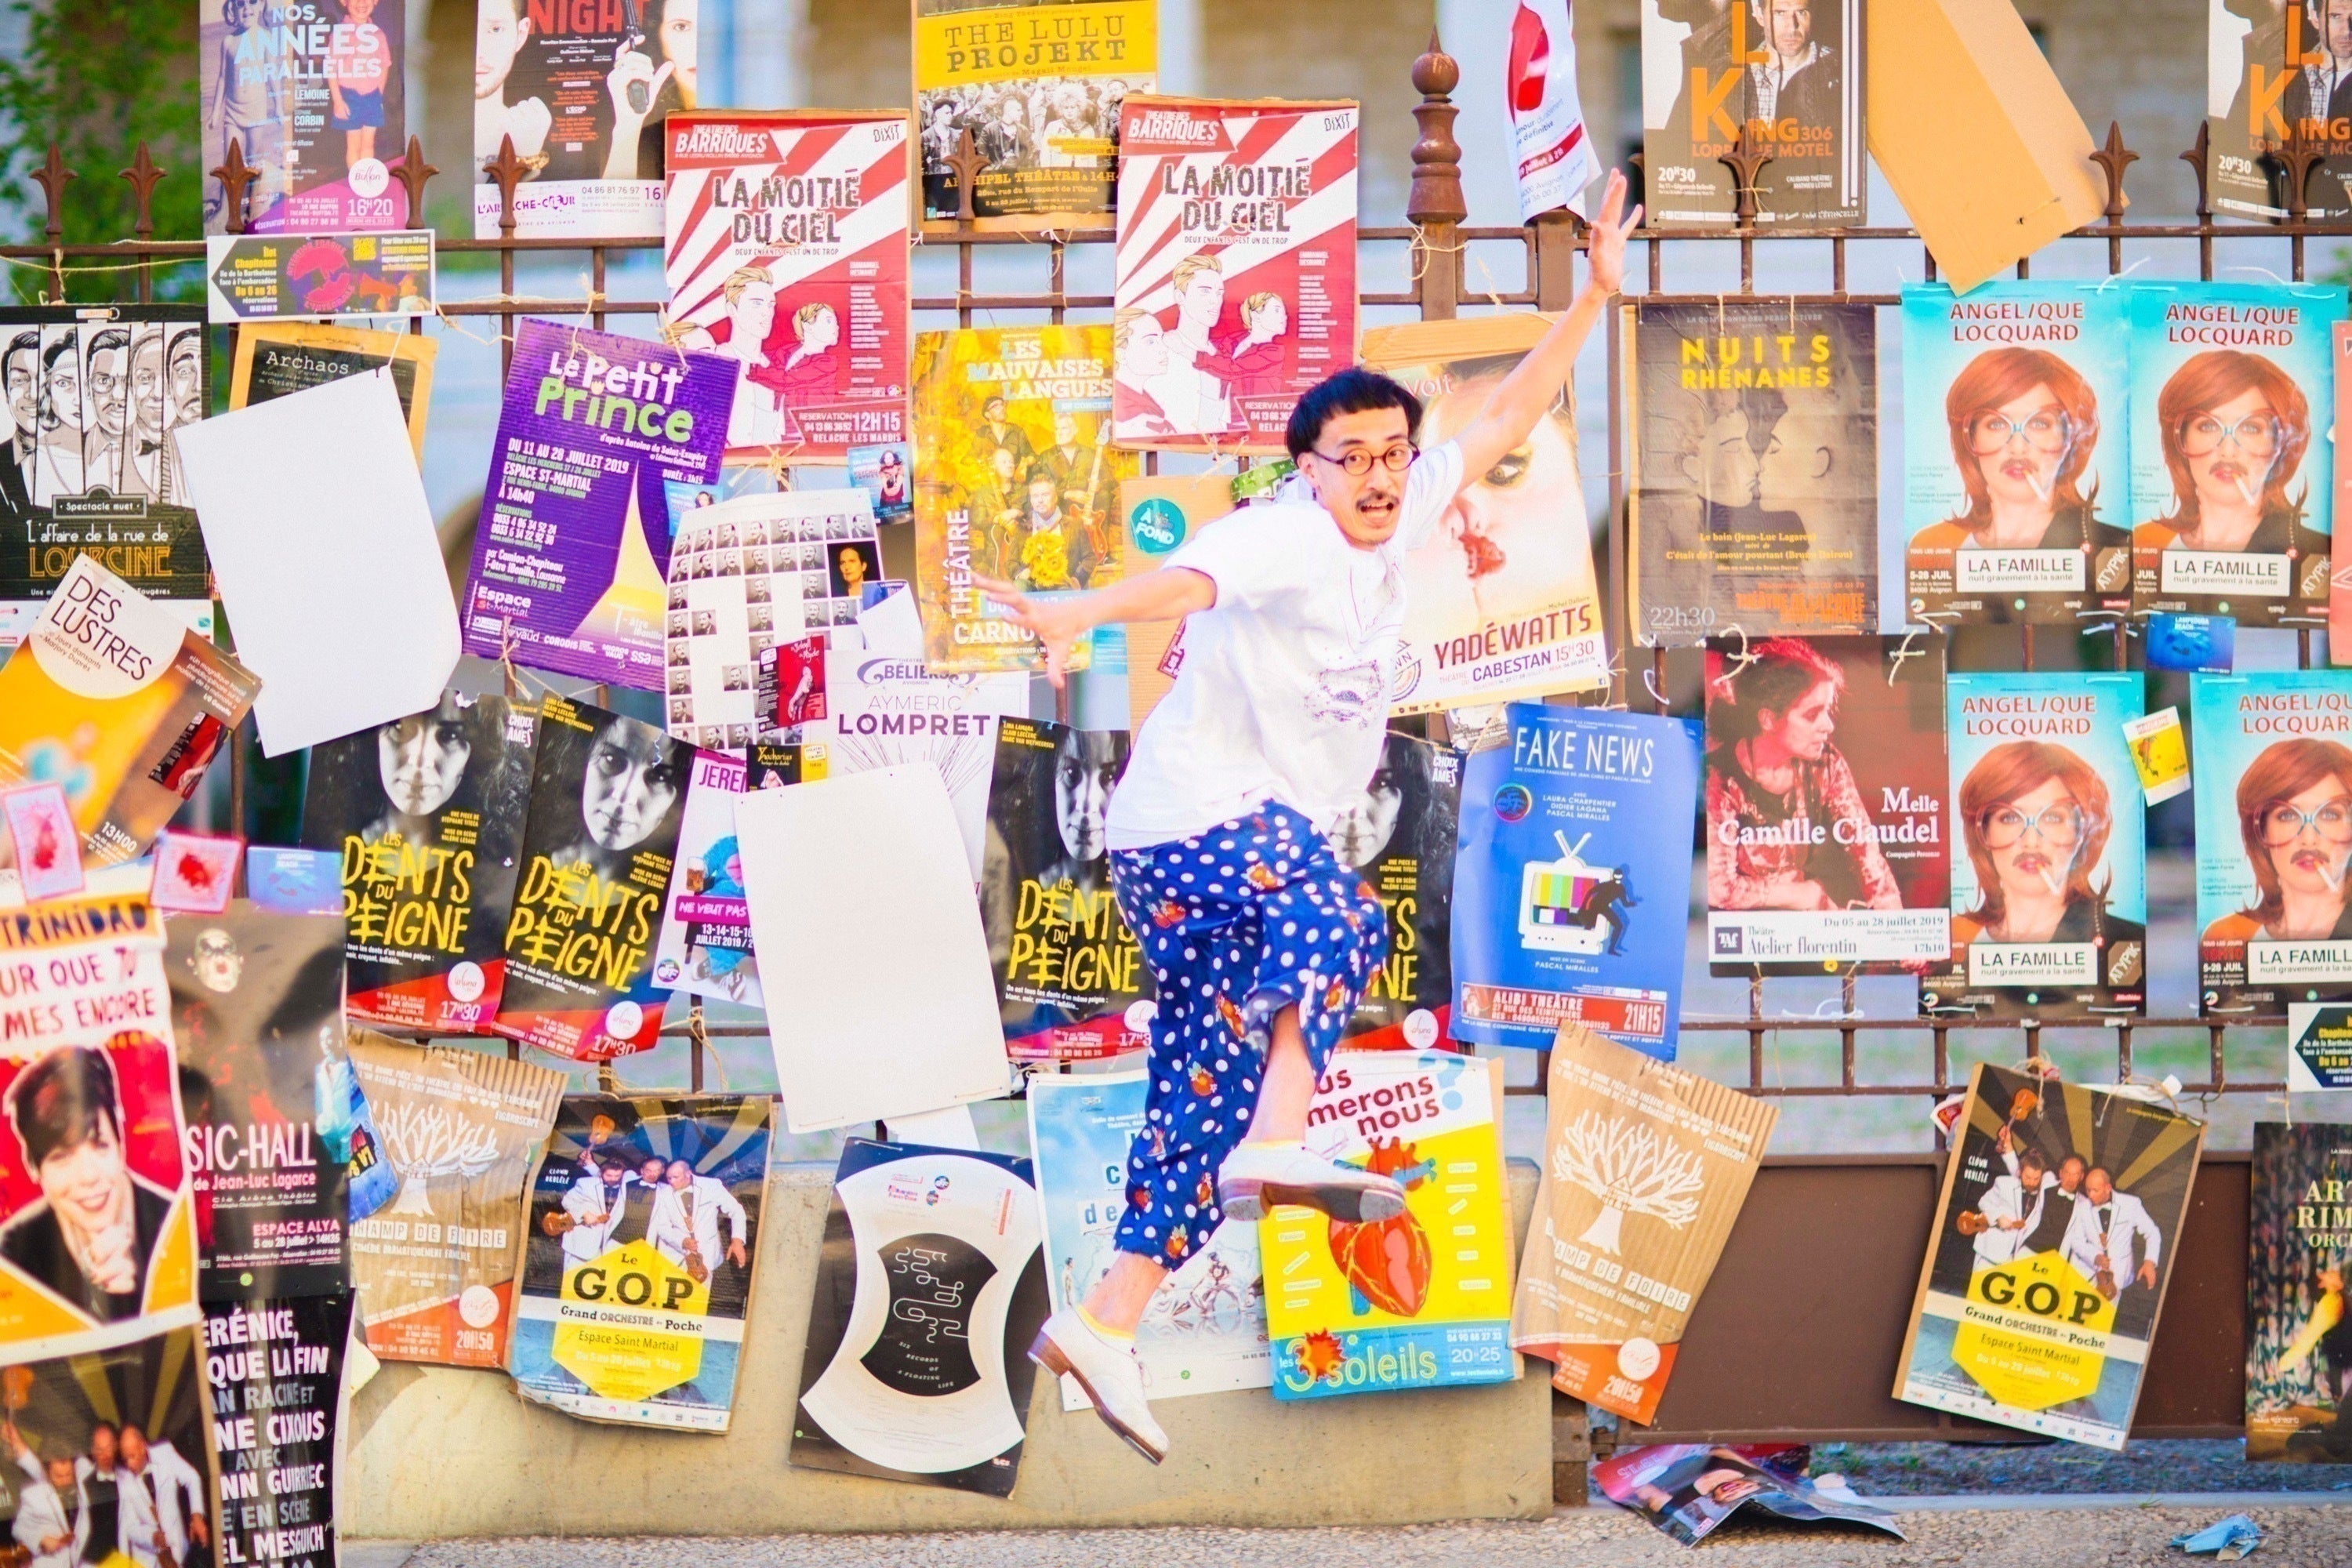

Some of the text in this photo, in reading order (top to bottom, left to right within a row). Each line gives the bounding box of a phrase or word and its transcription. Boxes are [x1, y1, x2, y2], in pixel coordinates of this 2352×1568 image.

[273, 5, 316, 23] NOS
[234, 17, 379, 64] ANNÉES
[945, 16, 1125, 48] THE LULU
[947, 39, 1125, 73] PROJEKT
[239, 55, 382, 87] PARALLÈLES
[294, 115, 324, 126] CORBIN
[1127, 118, 1219, 140] BARRIQUES
[675, 133, 768, 153] BARRIQUES
[1802, 126, 1833, 141] 306
[1778, 143, 1833, 157] MOTEL
[713, 169, 861, 208] LA MOITIÉ
[1165, 158, 1312, 197] LA MOITIÉ
[348, 198, 393, 216] 16H20
[1183, 199, 1290, 232] DU CIEL
[733, 212, 840, 243] DU CIEL
[1950, 302, 2085, 321] ANGEL/QUE
[2165, 304, 2300, 325] ANGEL/QUE
[1953, 325, 2079, 343] LOCQUARD
[2169, 326, 2294, 347] LOCQUARD
[1001, 339, 1042, 361] LES
[1682, 335, 1831, 365] NUITS
[266, 350, 350, 376] Archaos
[966, 358, 1104, 381] MAUVAISES
[550, 352, 684, 405] Le Petit
[1682, 364, 1831, 390] RHÉNANES
[1002, 379, 1112, 401] LANGUES
[535, 376, 694, 442] Prince
[852, 412, 901, 431] 12H15
[813, 434, 901, 443] RELACHE LES MARDIS
[508, 437, 629, 474] DU AU JUILLET 2019
[503, 462, 592, 492] ESPACE ST-MARTIAL
[66, 502, 110, 511] Spectacle
[506, 487, 535, 504] 14h40
[85, 523, 169, 542] de la rue de
[1136, 522, 1174, 544] FOND
[1969, 558, 2073, 572] LA FAMILLE
[2174, 561, 2278, 576] LA FAMILLE
[1987, 574, 2031, 583] gravement
[67, 575, 122, 623] DES
[478, 586, 531, 608] Espace
[1650, 608, 1716, 627] 22h30
[51, 600, 152, 680] LUSTRES
[1434, 604, 1592, 670] YADÉWATTS
[1472, 650, 1551, 682] CABESTAN
[868, 695, 962, 710] AYMERIC
[1963, 696, 2096, 713] ANGEL/QUE
[509, 714, 534, 729] CHOIX
[838, 713, 990, 735] LOMPRET
[1966, 718, 2091, 736] LOCQUARD
[1433, 754, 1458, 768] CHOIX
[1514, 727, 1654, 778] FAKE NEWS
[1543, 795, 1617, 808] LAURA CHARPENTIER
[1882, 787, 1939, 813] Melle
[1577, 811, 1610, 821] MIRALLES
[383, 832, 402, 847] LES
[1718, 816, 1939, 846] Camille Claudel
[343, 836, 474, 903] DENTS
[572, 860, 592, 877] LES
[376, 884, 394, 900] DU
[1059, 878, 1073, 893] LES
[519, 855, 659, 945] DENTS
[679, 902, 746, 917] NE VEUT PAS
[554, 909, 574, 927] DU
[1824, 916, 1944, 927] Du 05 au 28 juillet 2019
[695, 935, 741, 948] JUILLET 2019
[1054, 930, 1068, 944] DU
[1748, 938, 1857, 955] Atelier florentin
[1914, 943, 1944, 953] 17h10
[505, 907, 647, 993] PEIGNE
[1981, 952, 2085, 967] LA FAMILLE
[1008, 934, 1140, 993] PEIGNE
[1535, 961, 1599, 973] PASCAL MIRALLES
[1624, 1003, 1661, 1033] 21H15
[1357, 1098, 1439, 1136] nous
[1968, 1155, 1988, 1169] CLOWN
[212, 1172, 315, 1191] Jean-Luc Lagarce
[252, 1220, 340, 1237] ESPACE ALYA
[621, 1253, 637, 1265] Le
[2032, 1262, 2049, 1275] Le
[573, 1268, 693, 1311] G.O.P
[1595, 1258, 1691, 1312] DE FOIRE
[1981, 1272, 2101, 1325] G.O.P
[561, 1305, 702, 1332] Grand ORCHESTRE Poche
[1965, 1306, 2107, 1348] Grand ORCHESTRE Poche
[579, 1330, 679, 1352] Espace Saint Martial
[1980, 1334, 2081, 1367] Espace Saint Martial
[206, 1346, 329, 1388] QUE LA FIN
[906, 1353, 939, 1363] RECORDS
[1326, 1341, 1437, 1388] soleils
[244, 1382, 314, 1410] RACINE ET
[267, 1410, 325, 1446] CIXOUS
[235, 1448, 281, 1471] AVEC
[241, 1494, 310, 1530] EN SCÈNE
[253, 1525, 325, 1561] MESGUICH
